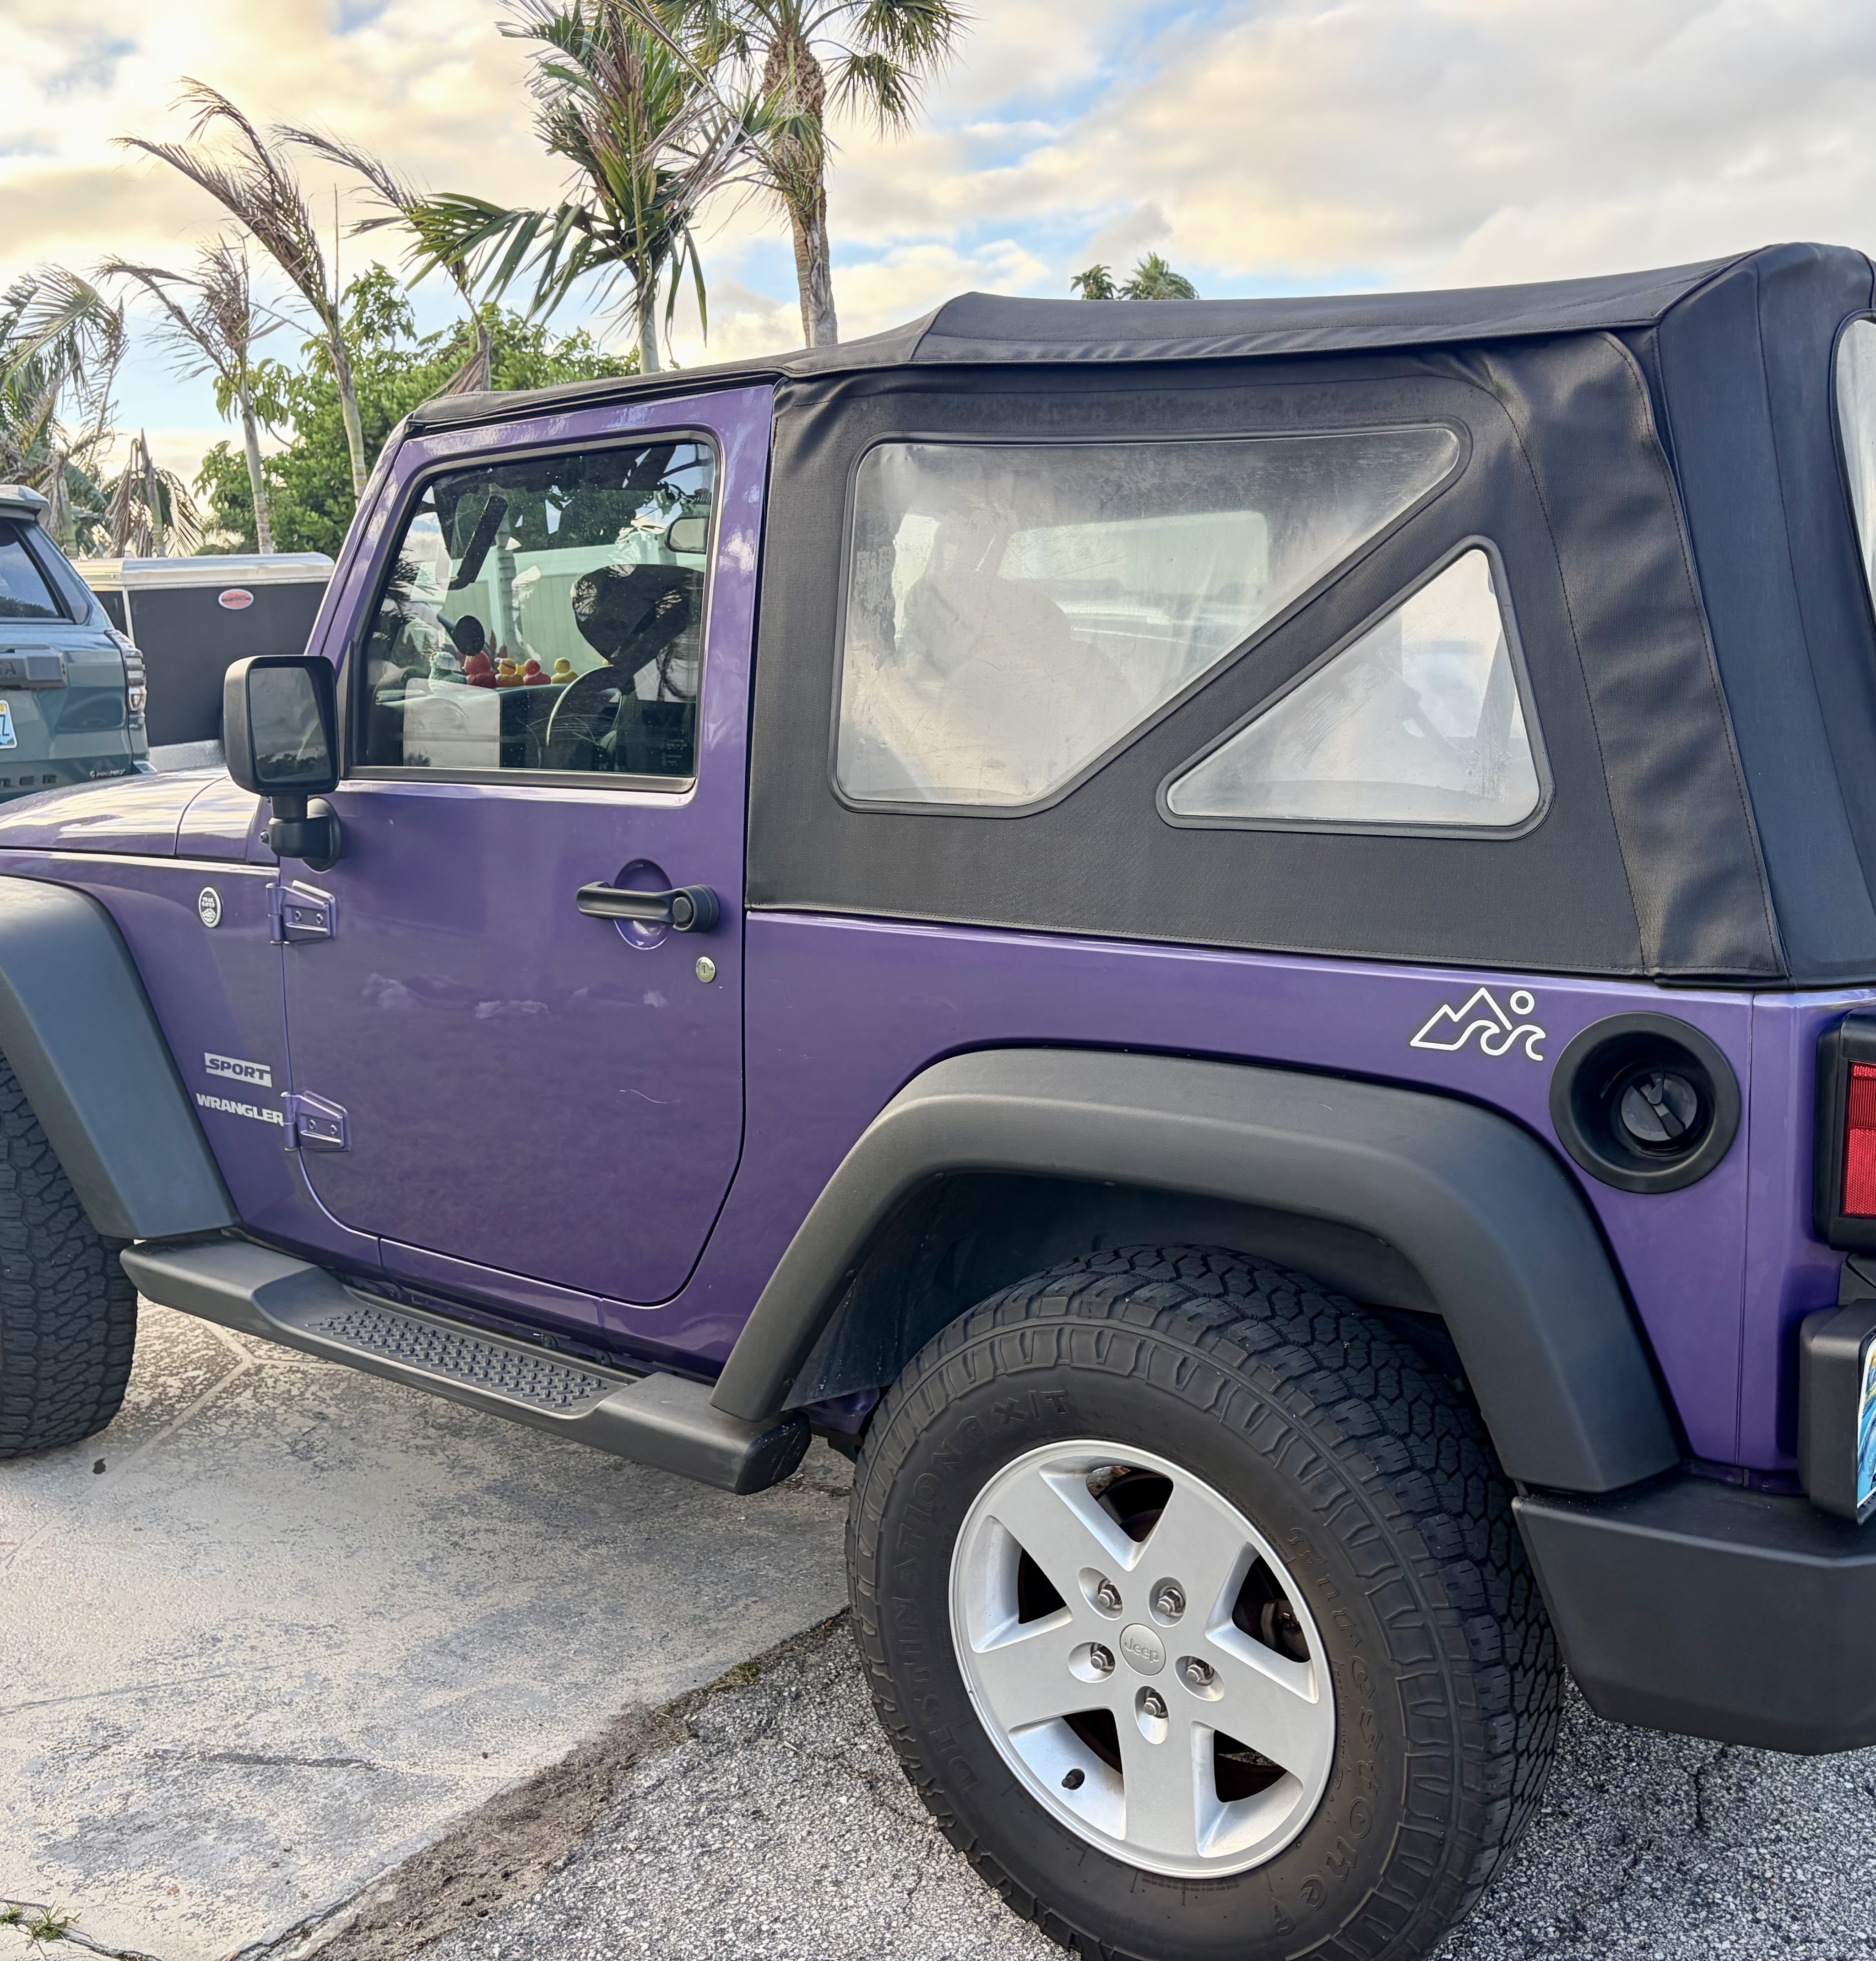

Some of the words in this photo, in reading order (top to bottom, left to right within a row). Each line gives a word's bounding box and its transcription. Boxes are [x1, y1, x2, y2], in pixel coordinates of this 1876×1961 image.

[206, 1058, 271, 1081] SPORT
[196, 1093, 284, 1127] WRANGLER
[893, 1437, 980, 1792] DESTINATION
[991, 1390, 1068, 1426] X/T
[1124, 1638, 1160, 1663] Jeep
[1286, 1527, 1383, 1910] Firestone
